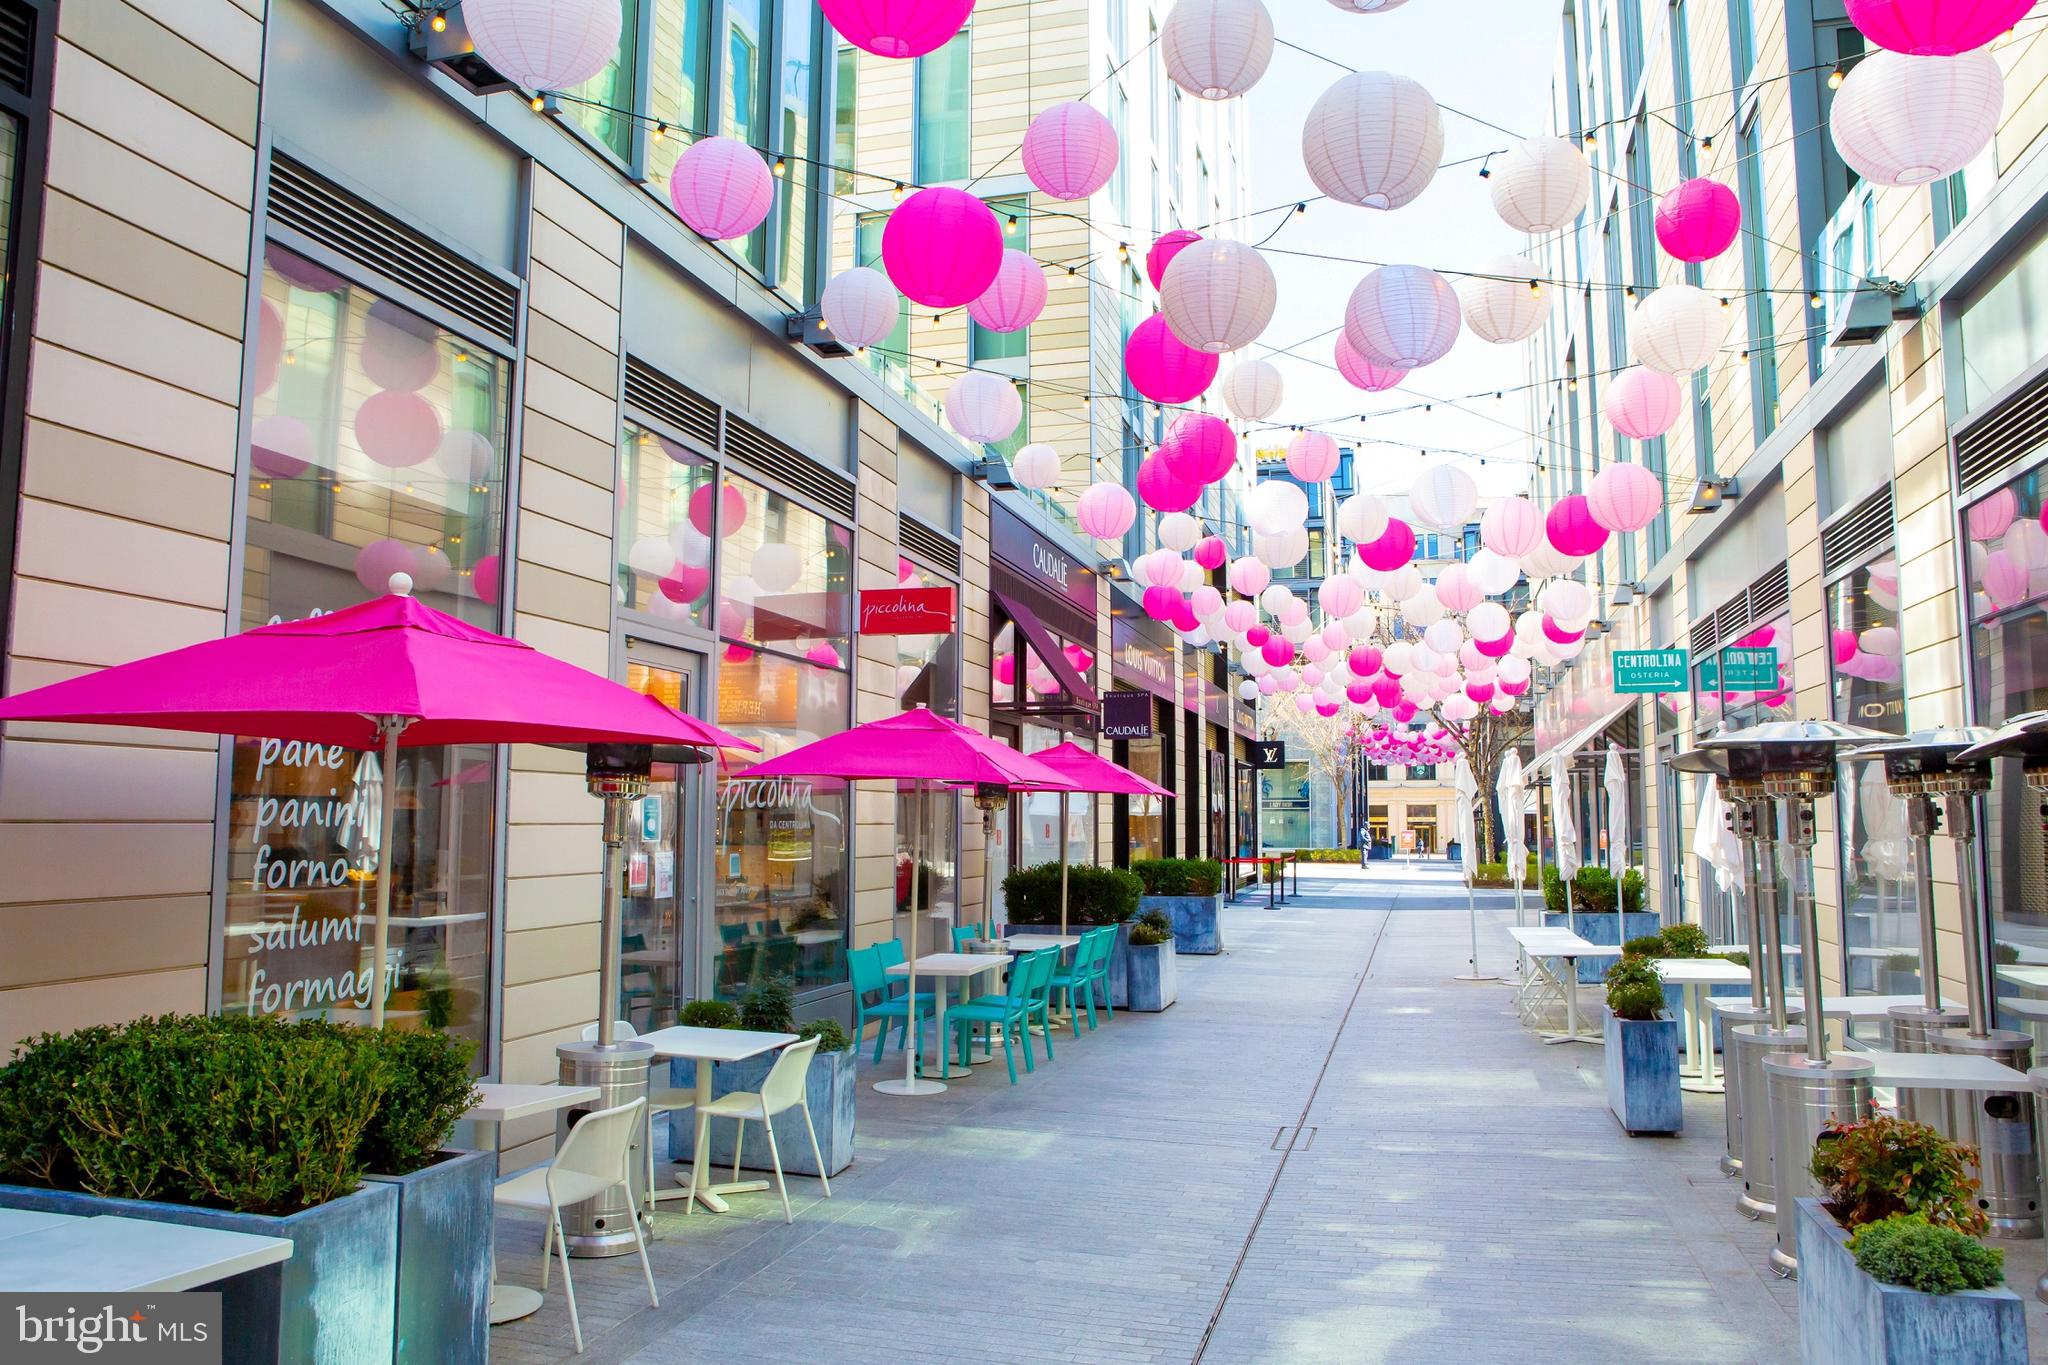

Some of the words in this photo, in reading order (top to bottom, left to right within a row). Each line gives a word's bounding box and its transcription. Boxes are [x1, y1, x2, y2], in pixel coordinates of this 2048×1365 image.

[1032, 543, 1068, 588] CAUDALÍE
[863, 595, 948, 629] piccolina
[1125, 643, 1143, 672] LOUIS
[1143, 654, 1166, 684] VUITTON
[1617, 654, 1682, 669] CENTROLINA
[1630, 671, 1670, 679] OSTERIA
[1105, 723, 1149, 735] CAUDALÍE
[256, 737, 344, 781] pane
[253, 787, 367, 844] panini
[252, 844, 349, 891] forno
[248, 902, 366, 954] salumi
